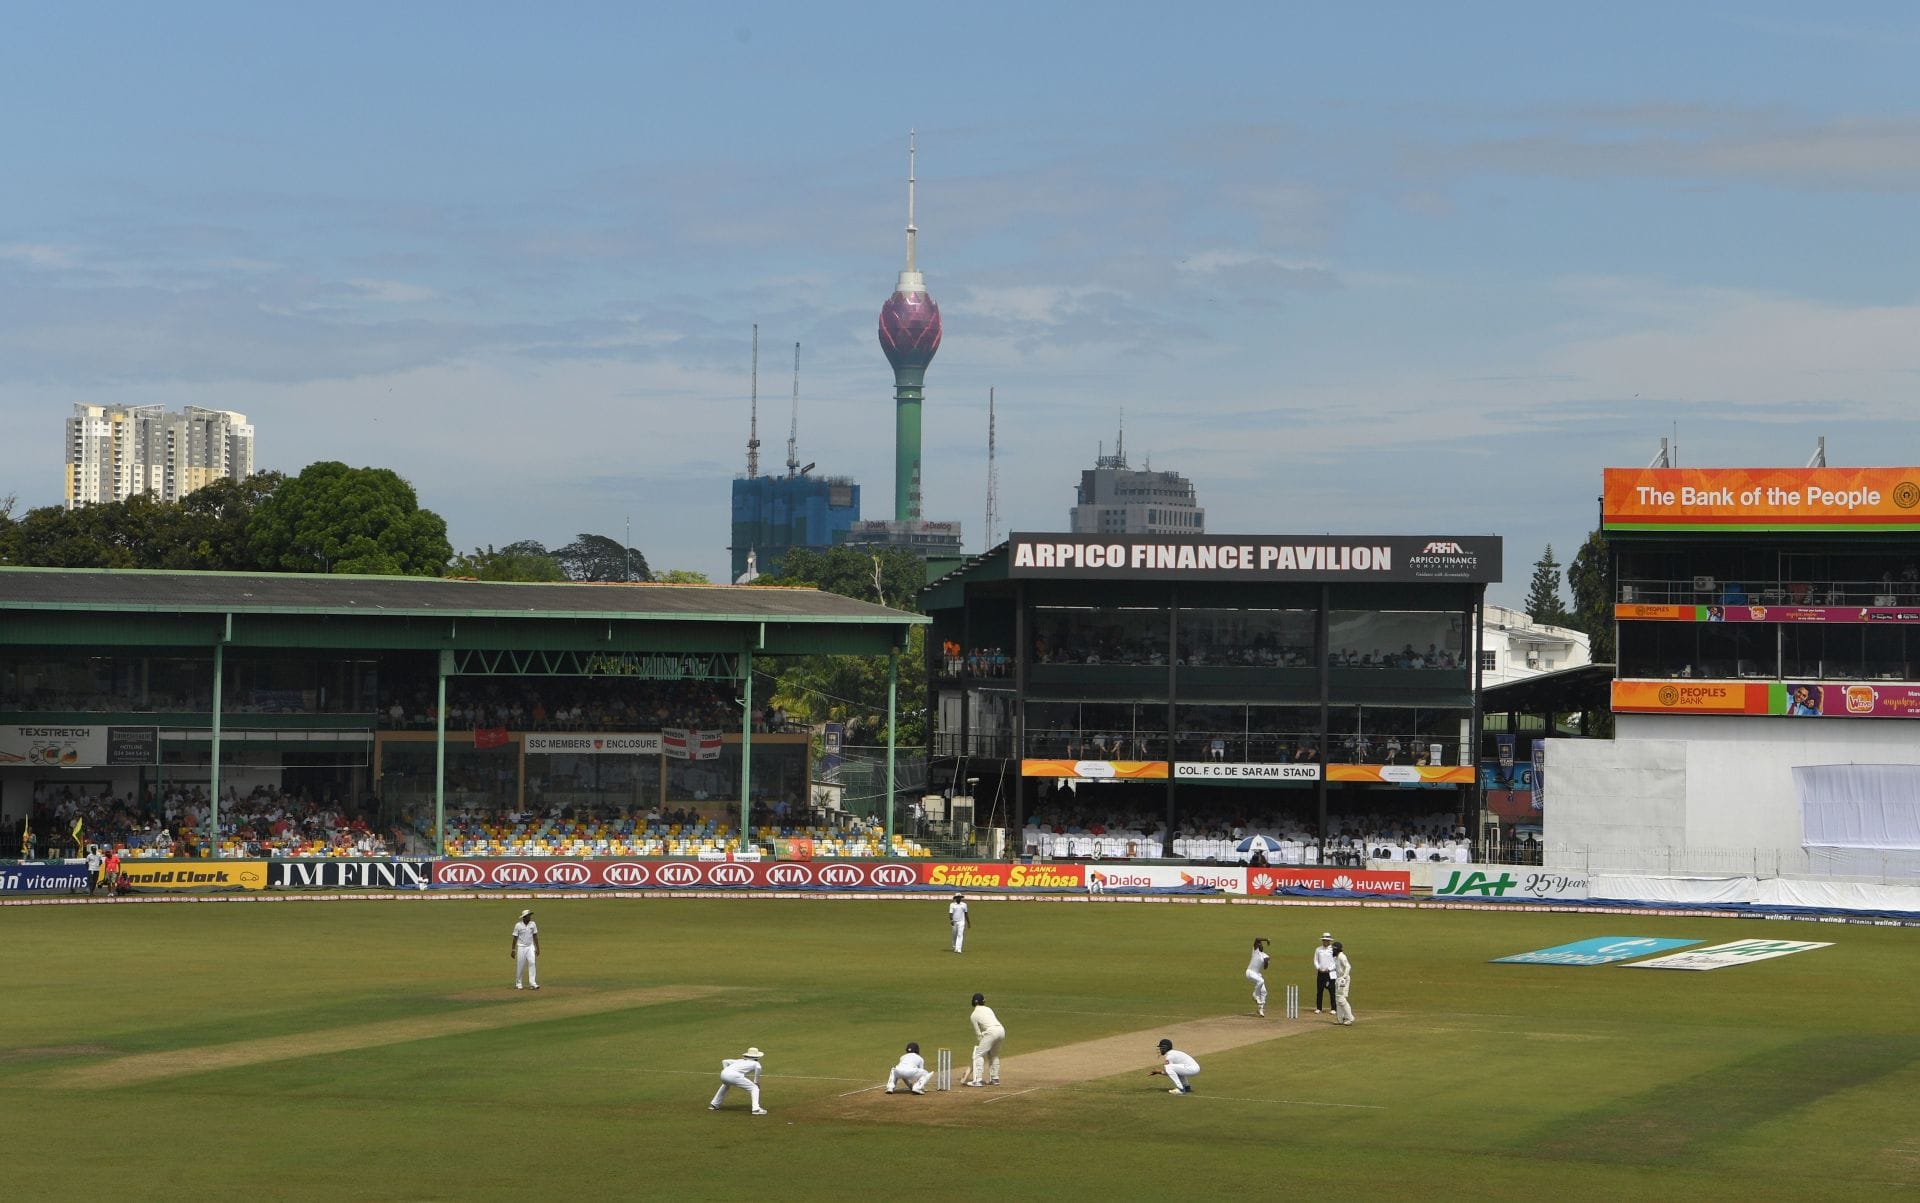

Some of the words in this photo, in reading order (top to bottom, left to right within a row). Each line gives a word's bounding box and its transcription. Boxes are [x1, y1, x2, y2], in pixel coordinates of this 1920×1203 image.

[1636, 486, 1675, 505] The
[1681, 486, 1735, 506] Bank
[1740, 487, 1762, 506] of
[1767, 487, 1801, 506] the
[1807, 487, 1881, 509] People
[1014, 543, 1126, 568] ARPICO
[1131, 544, 1255, 569] FINANCE
[1260, 546, 1392, 570] PAVILION
[1409, 556, 1441, 564] ARPICO
[1680, 688, 1727, 697] PEOPLE'S
[1680, 697, 1703, 705] BANK
[18, 728, 89, 737] TEXSTRETCH
[529, 739, 547, 749] SSC
[549, 739, 591, 749] MEMBERS
[606, 739, 658, 749] ENCLOSURE
[1179, 766, 1202, 775] COL.
[1225, 767, 1238, 775] DE
[1242, 767, 1279, 776] SARAM
[1283, 768, 1316, 777] STAND
[176, 871, 229, 883] Clark
[274, 863, 327, 886] JM
[336, 863, 426, 886] FINN
[446, 868, 478, 882] KIA
[500, 868, 529, 882] KIA
[553, 868, 582, 882] KIA
[611, 868, 642, 882] KIA
[663, 868, 694, 882] KIA
[716, 868, 747, 882] KIA
[774, 868, 804, 882] KIA
[826, 868, 857, 883] KIA
[879, 869, 909, 883] KIA
[929, 865, 1000, 887] Sathosa
[1007, 866, 1079, 887] Sathosa
[1109, 874, 1151, 887] Dialog
[27, 875, 88, 889] vitamins
[1196, 875, 1238, 889] Dialog
[1276, 878, 1325, 889] HUAWEI
[1357, 881, 1405, 891] HUAWEI
[1524, 873, 1555, 898] 25
